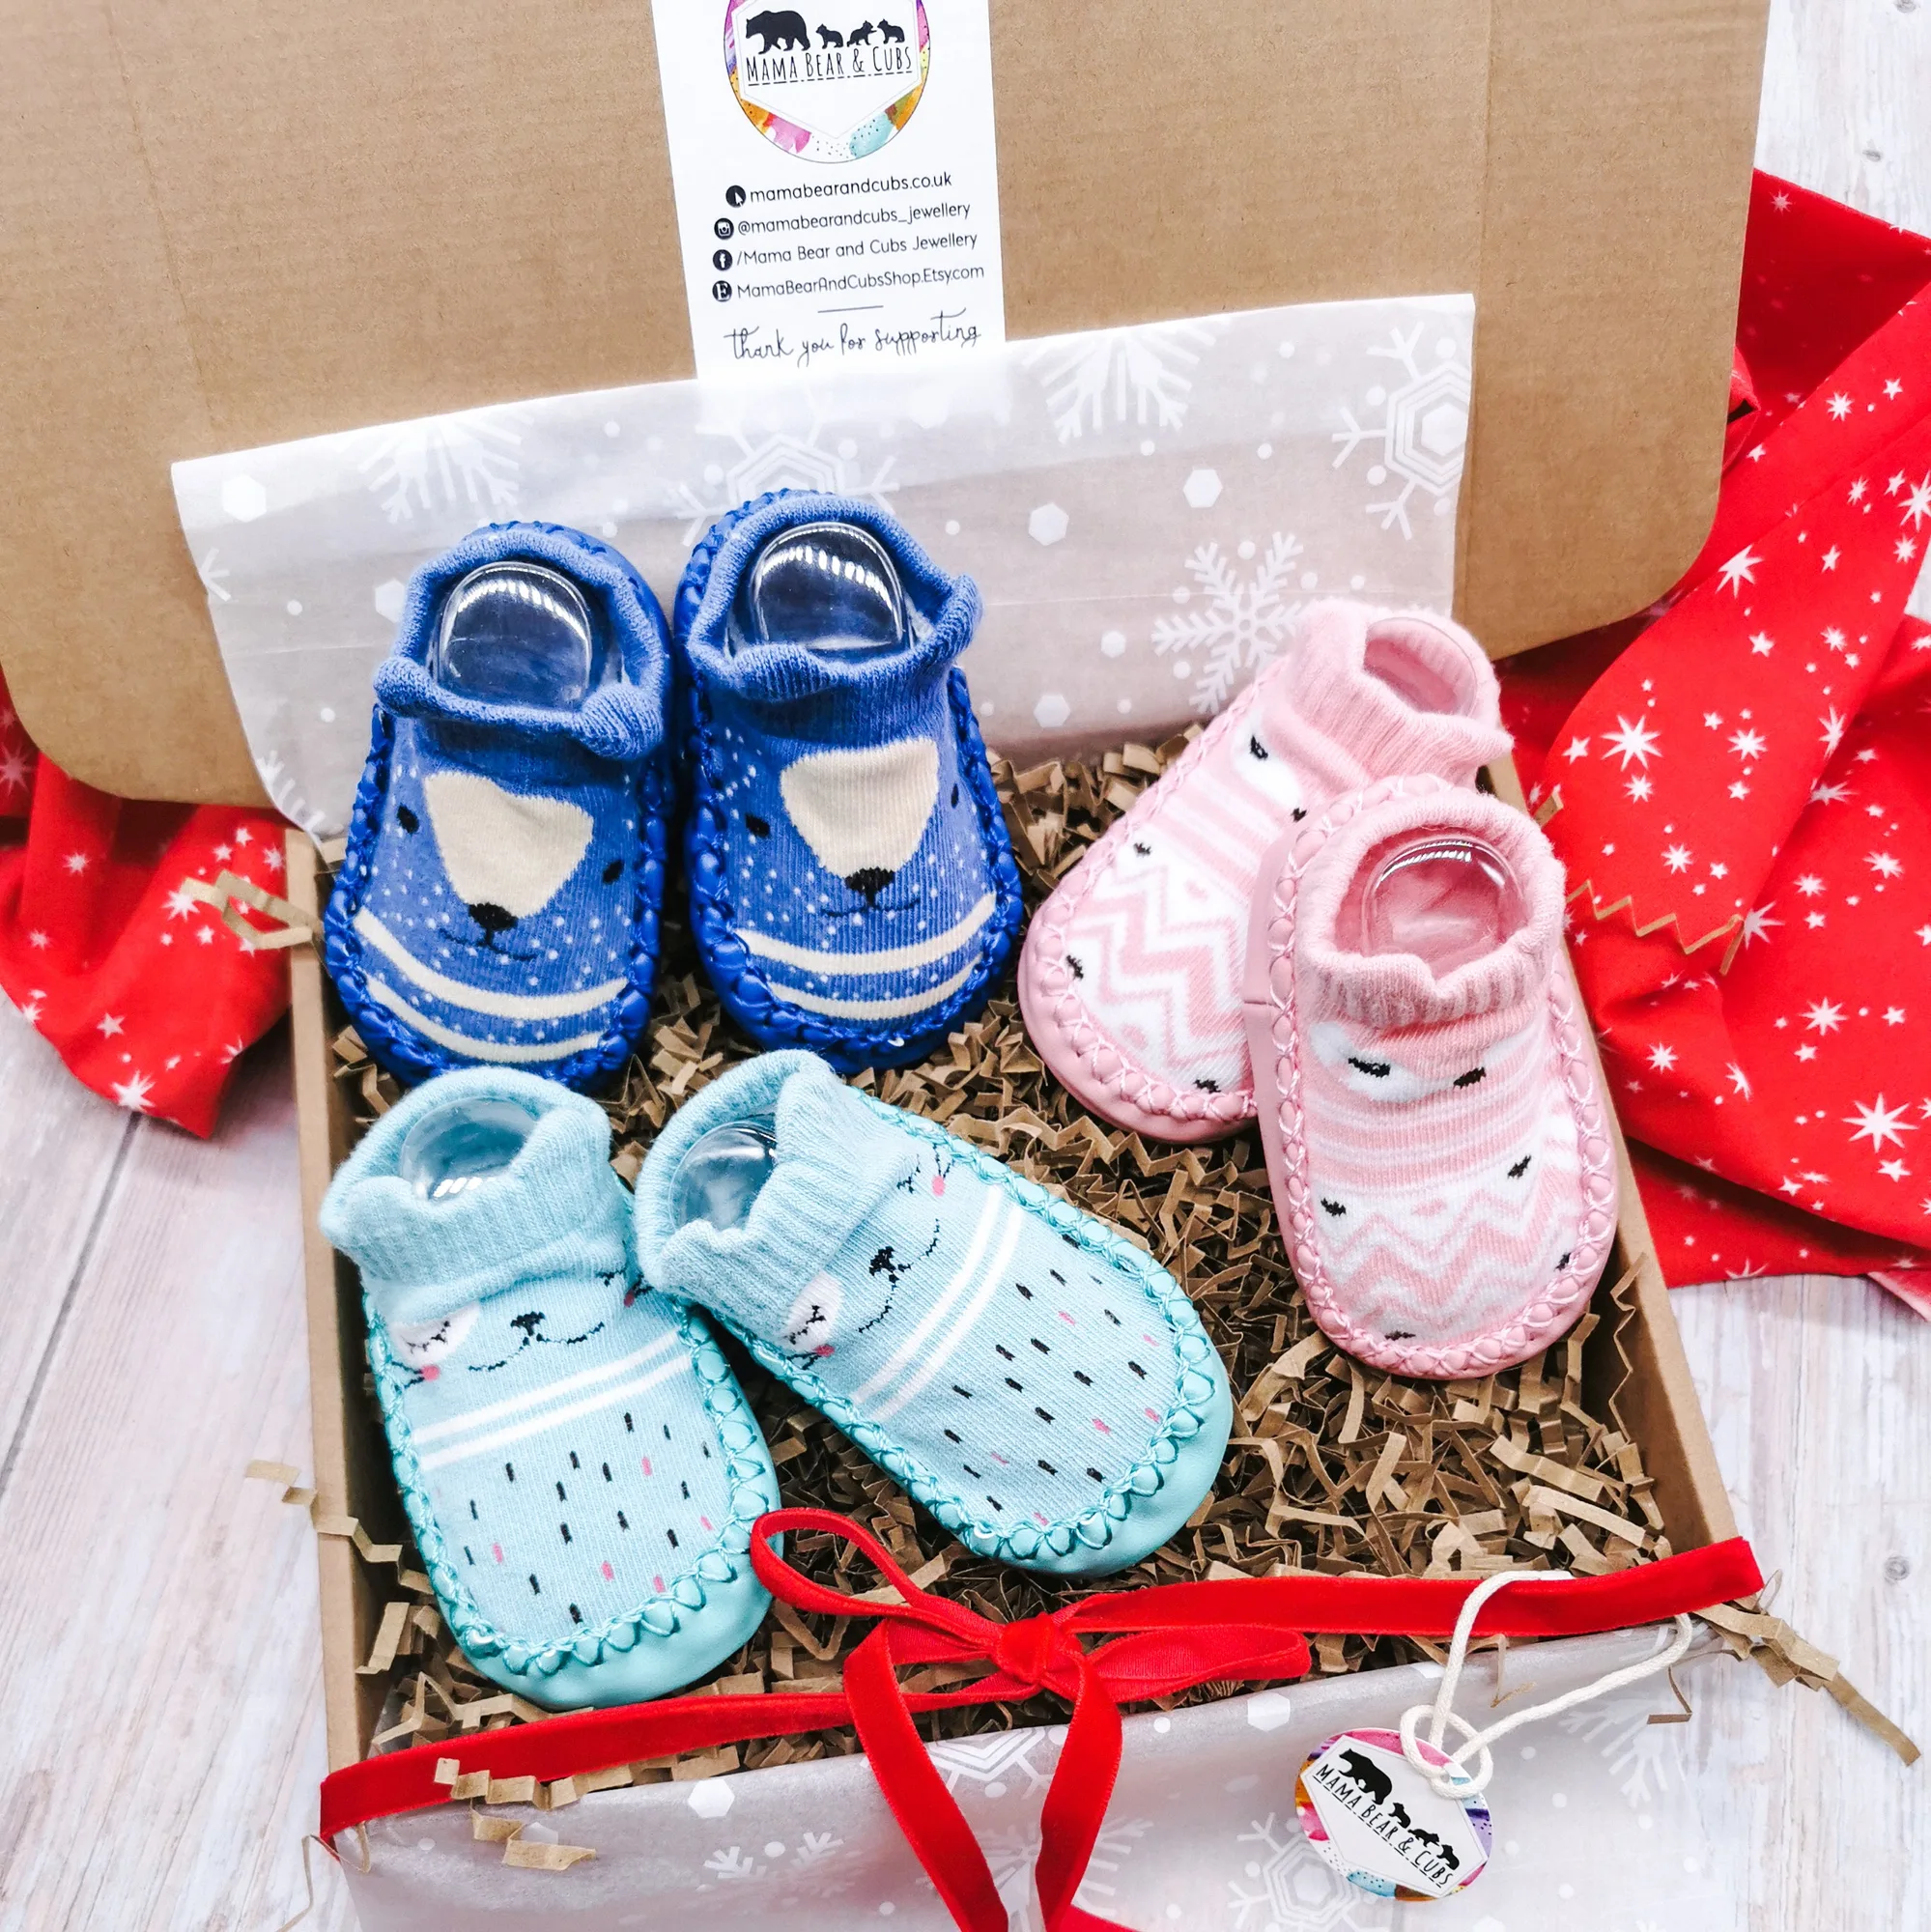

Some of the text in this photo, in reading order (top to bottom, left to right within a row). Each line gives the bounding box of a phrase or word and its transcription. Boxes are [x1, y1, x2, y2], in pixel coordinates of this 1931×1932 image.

[852, 47, 865, 72] &
[750, 171, 952, 203] mamabearandcubs.co.uk
[738, 202, 971, 236] @mamabearandcubs_jewellery
[798, 245, 830, 260] Bear
[836, 241, 865, 257] and
[869, 237, 907, 254] Cubs
[912, 233, 978, 251] Jewellery
[738, 265, 985, 298] MamaBearAndCubsShop.Etsy.com
[724, 326, 794, 359] thank
[797, 337, 835, 368] you
[874, 307, 981, 356] supporting
[1398, 1836, 1411, 1854] &
